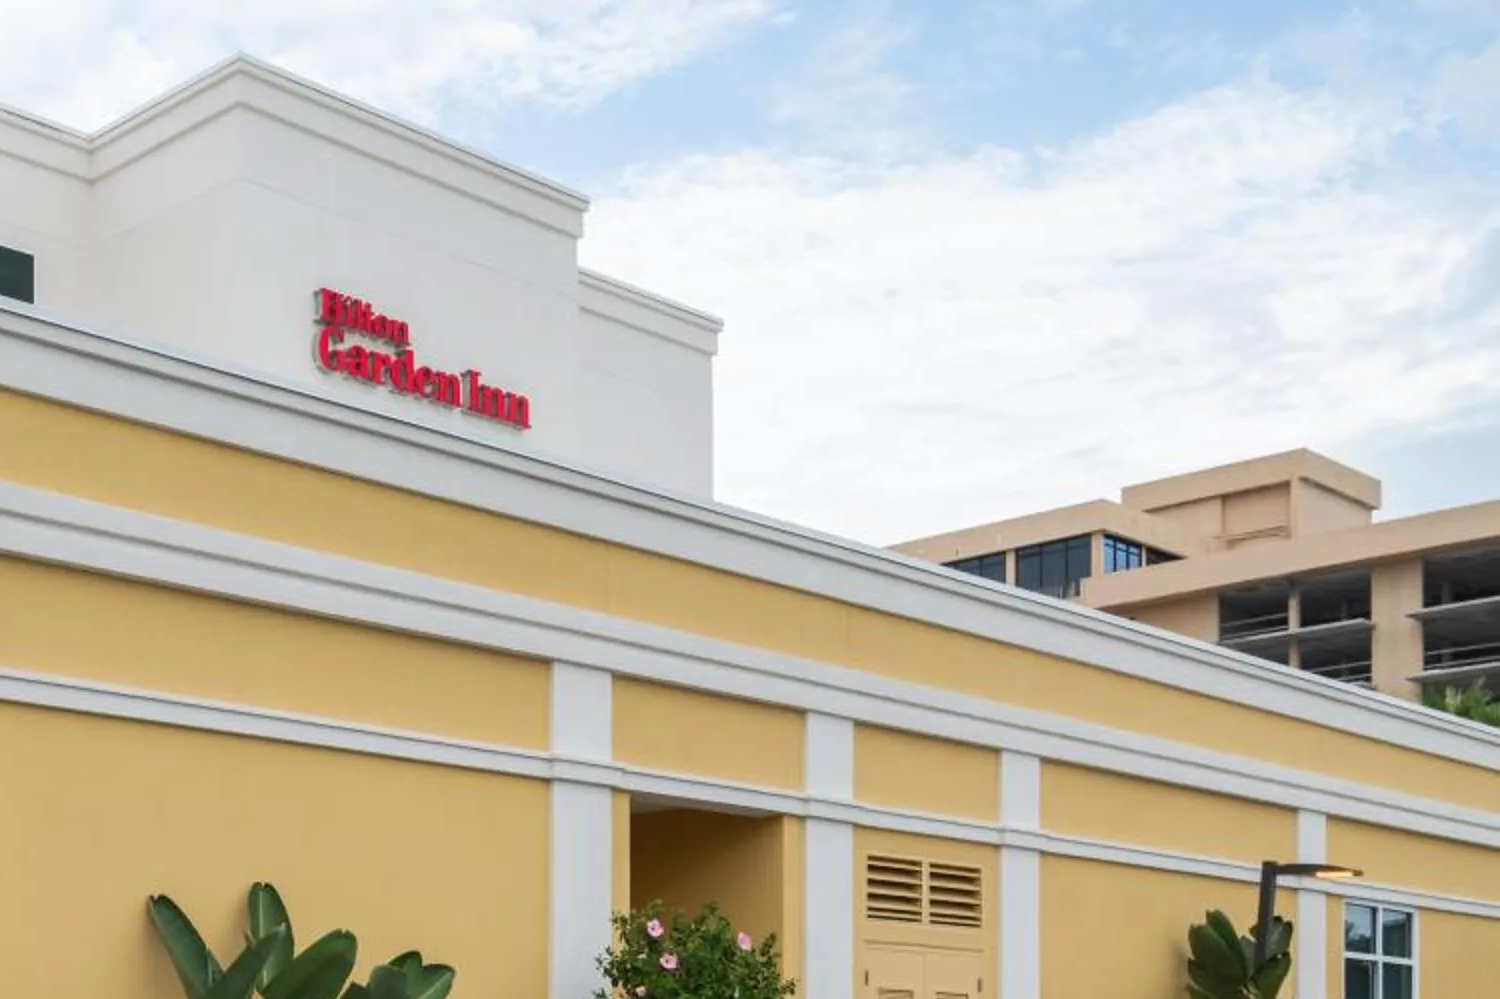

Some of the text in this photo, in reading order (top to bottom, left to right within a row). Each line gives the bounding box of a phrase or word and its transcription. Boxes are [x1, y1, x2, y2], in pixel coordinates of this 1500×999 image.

[314, 287, 411, 347] Hilton
[313, 326, 532, 430] Garden Inn
